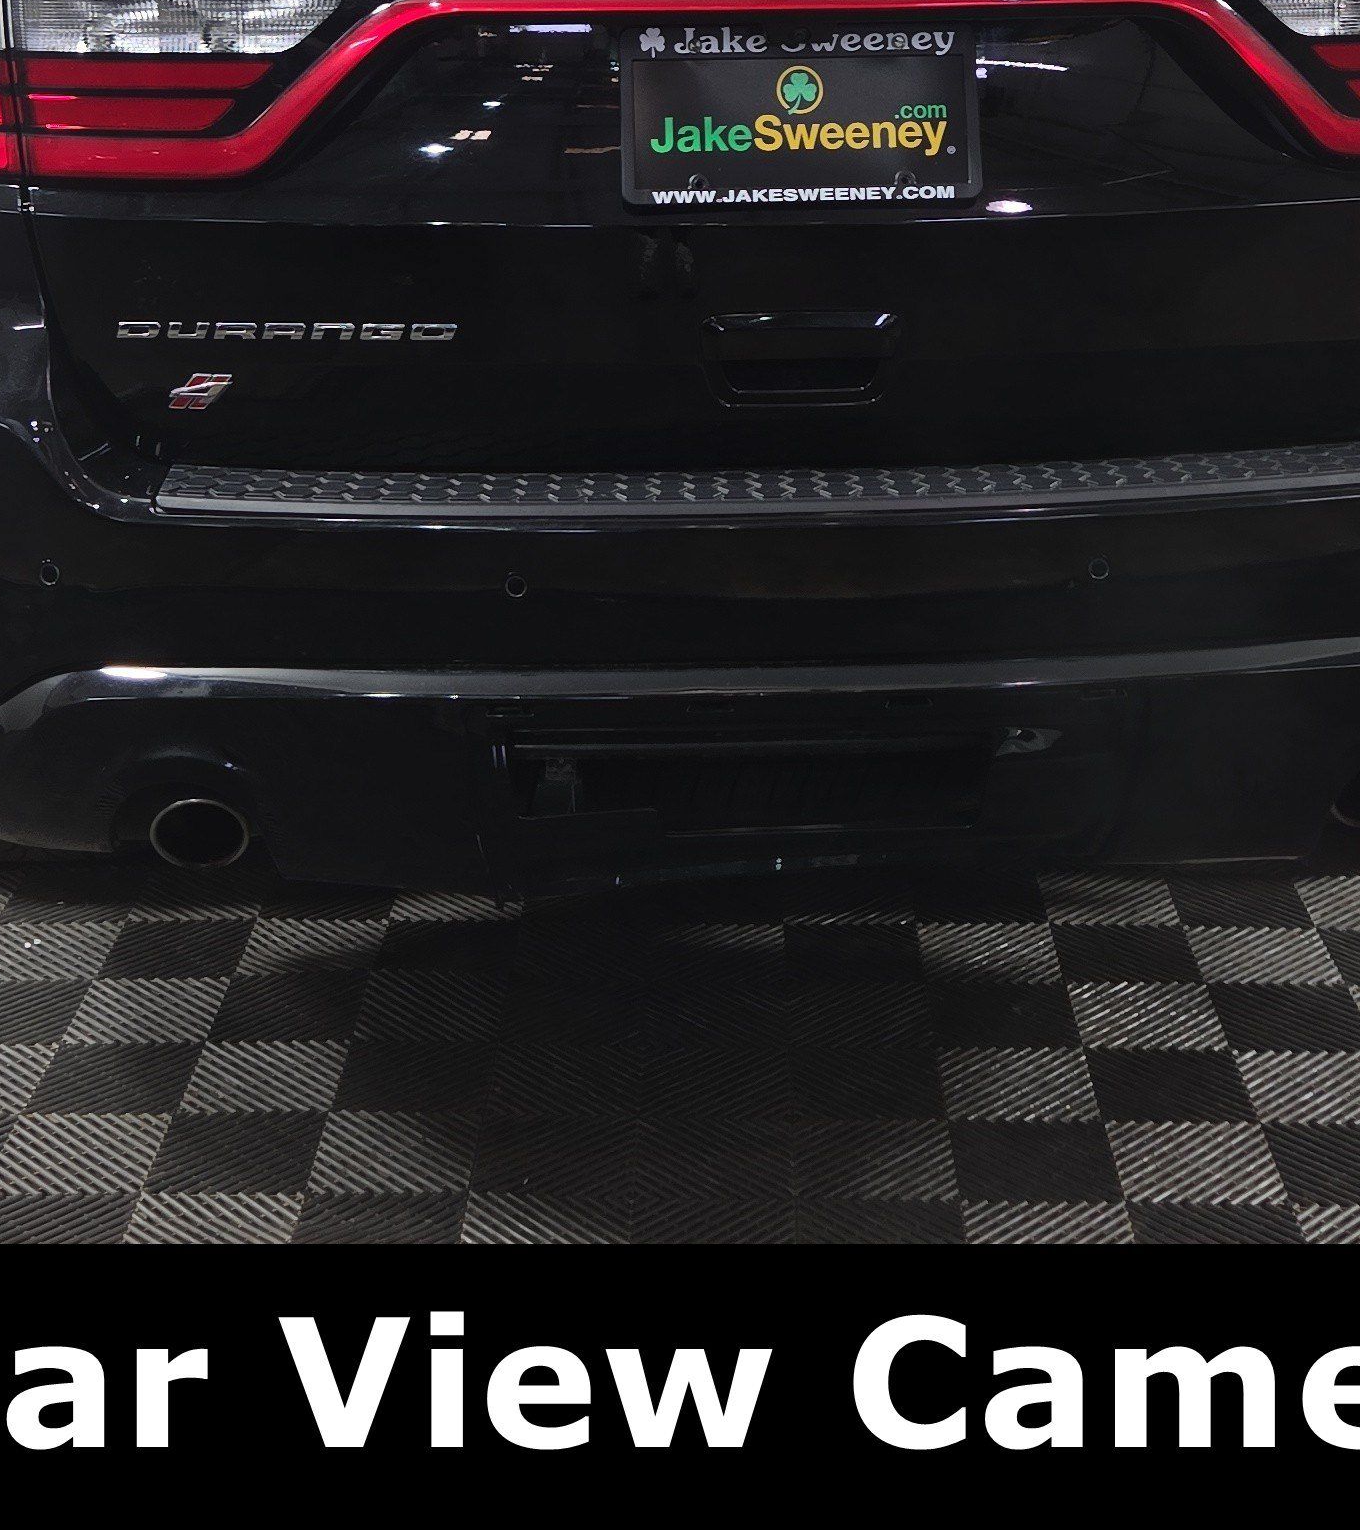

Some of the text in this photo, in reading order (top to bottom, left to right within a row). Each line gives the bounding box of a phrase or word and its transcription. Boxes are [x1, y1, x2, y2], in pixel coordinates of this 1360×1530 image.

[674, 27, 767, 54] Jake
[894, 103, 947, 120] .com
[651, 186, 955, 204] WWW.JAKESWEENEY.COM
[116, 321, 458, 341] DURANGO
